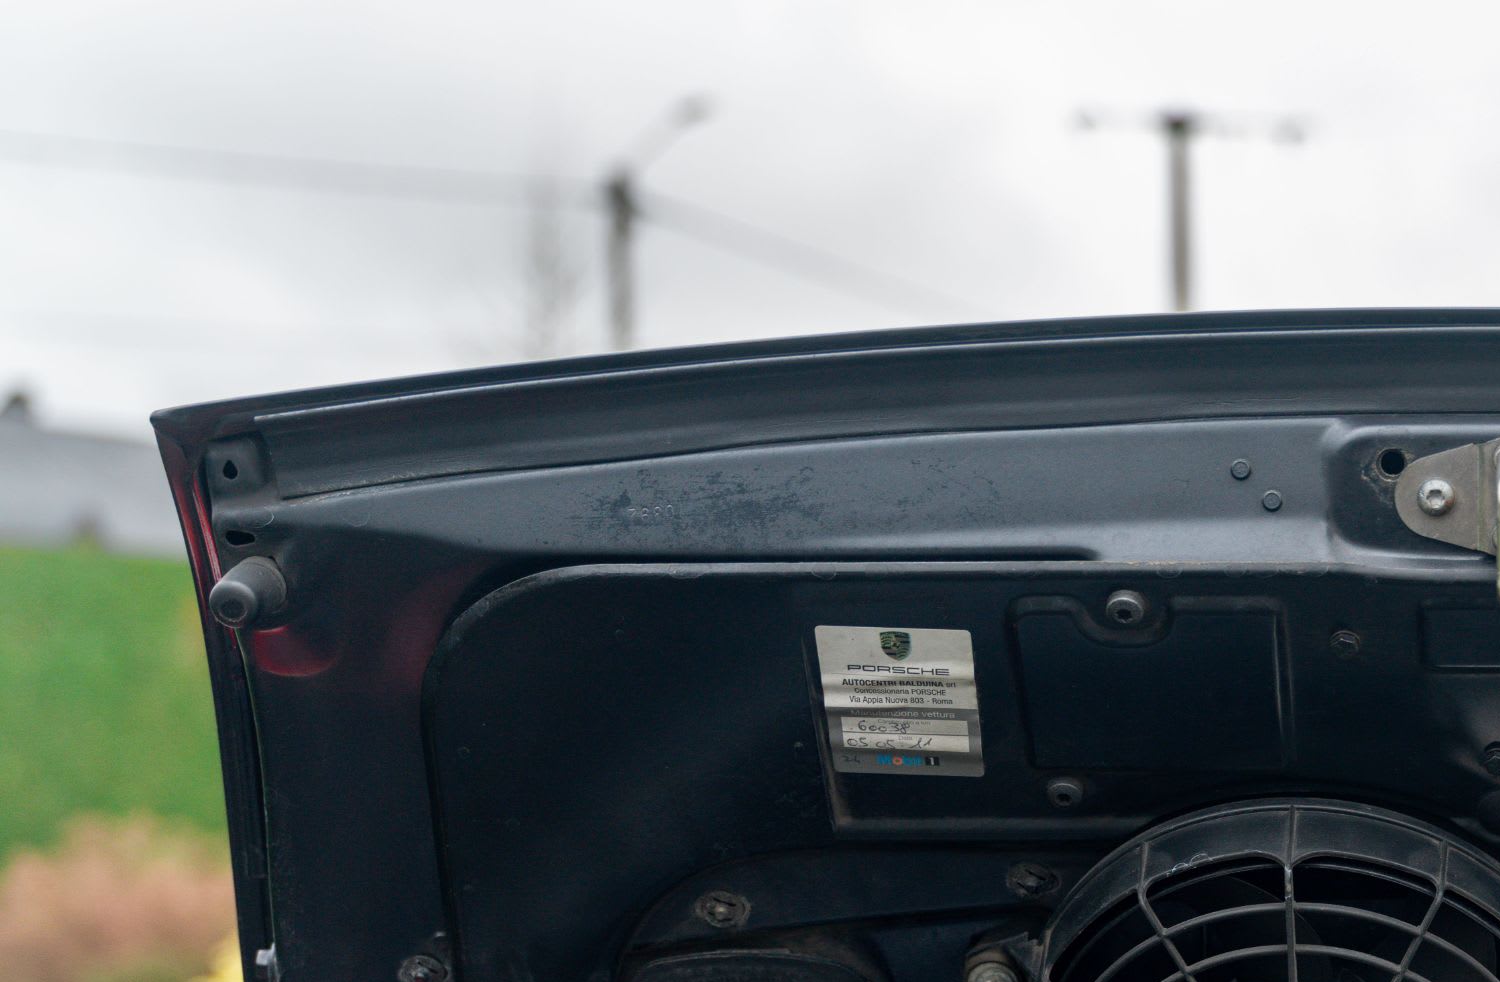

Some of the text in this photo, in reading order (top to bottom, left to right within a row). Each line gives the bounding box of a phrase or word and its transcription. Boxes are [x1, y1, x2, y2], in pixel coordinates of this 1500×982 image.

[847, 664, 950, 676] PORSCHE
[841, 678, 897, 687] AUTOCENTRI
[899, 679, 944, 688] BALDUINA
[854, 687, 947, 696] Concessionaria PORSCHE
[849, 695, 861, 703] Via
[862, 696, 883, 705] Appia
[885, 696, 909, 704] Nuova
[850, 709, 956, 719] Manutenzione vettura
[876, 753, 923, 766] Mobil
